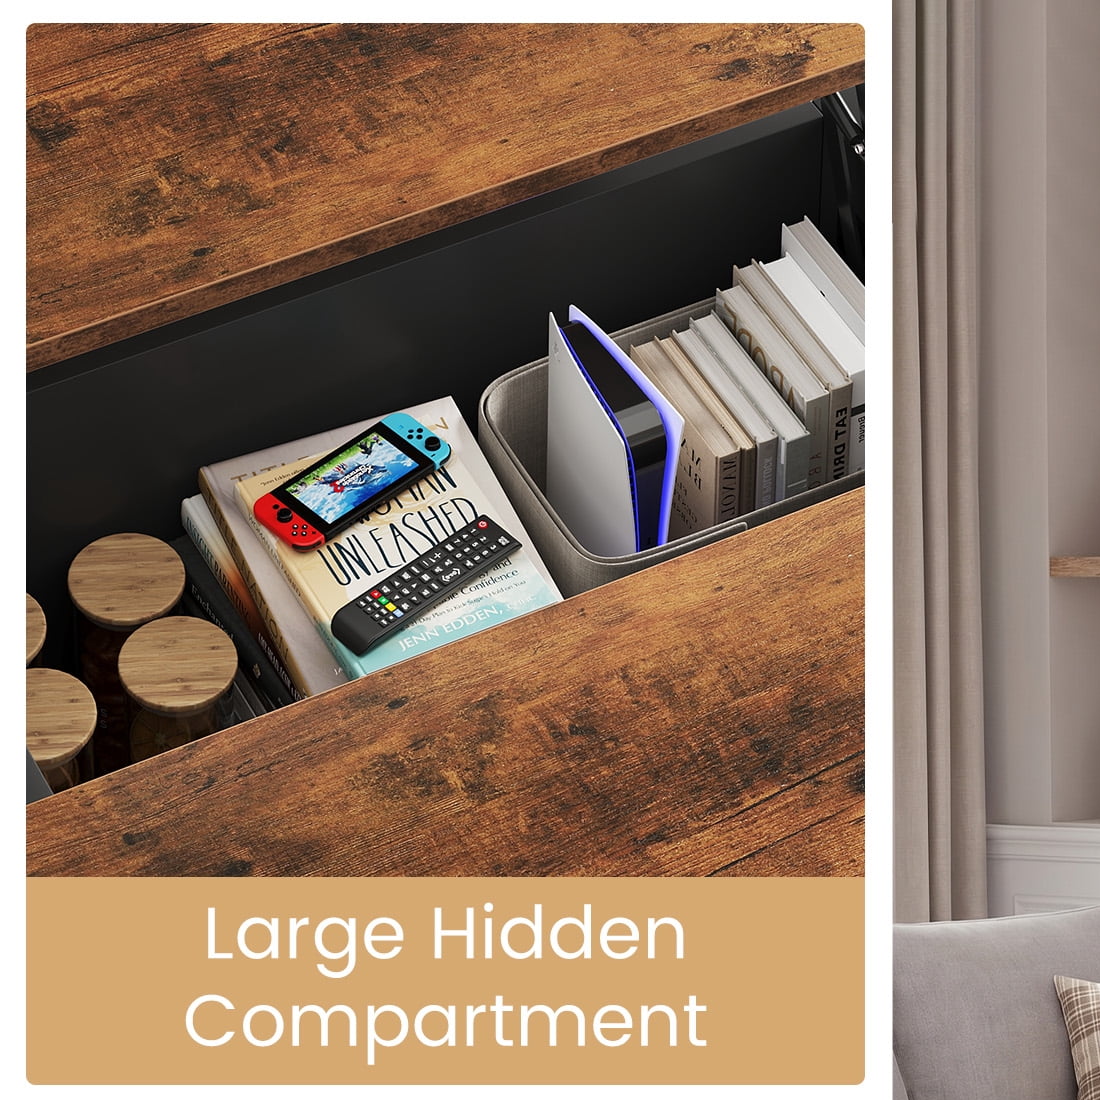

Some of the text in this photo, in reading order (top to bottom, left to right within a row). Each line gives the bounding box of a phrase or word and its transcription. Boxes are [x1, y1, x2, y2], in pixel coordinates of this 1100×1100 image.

[316, 498, 479, 586] UNLEASHED
[460, 569, 520, 595] Confidence
[399, 605, 503, 651] JENN EDDEN,
